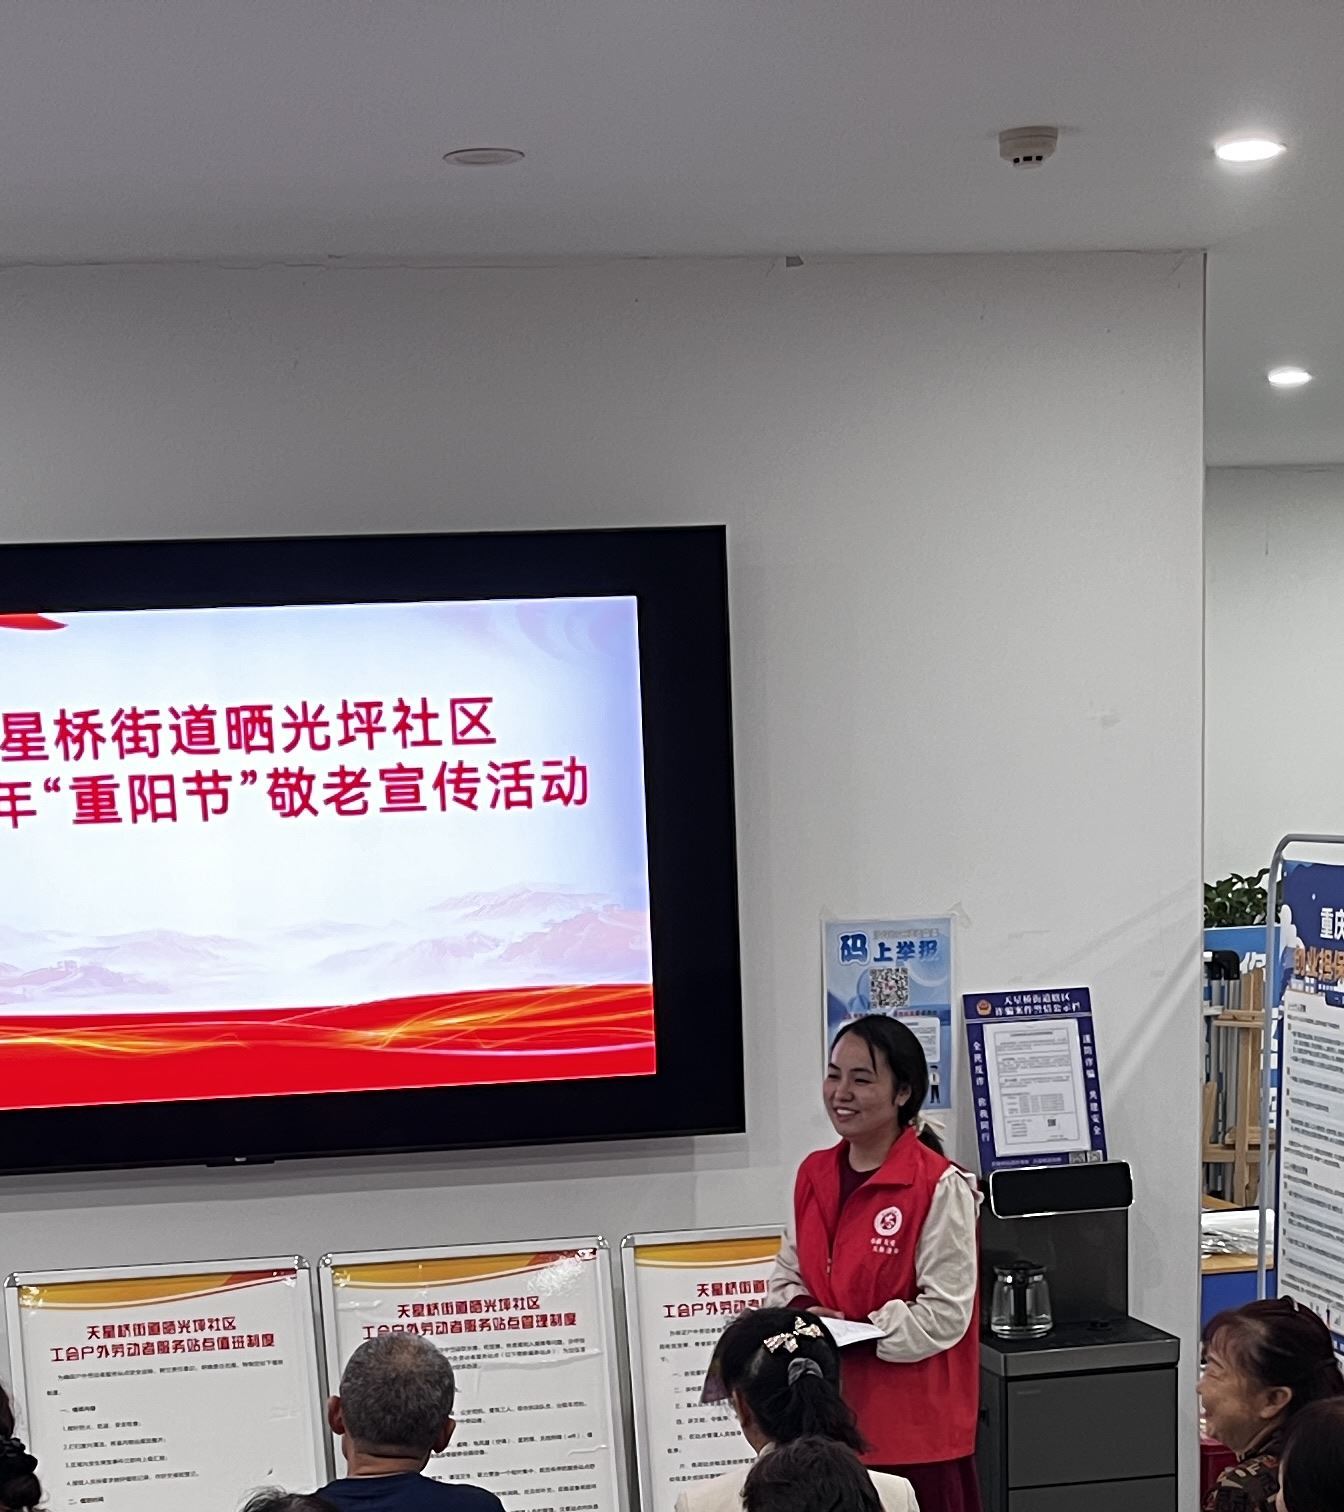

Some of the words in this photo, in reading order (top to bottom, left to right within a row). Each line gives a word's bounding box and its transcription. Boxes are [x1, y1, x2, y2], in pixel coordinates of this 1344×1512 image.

[840, 933, 937, 962] 码上举报
[397, 1296, 540, 1319] 天星桥街道晒光坪社区
[86, 1316, 236, 1341] 天星桥街道晒光坪社区
[50, 1333, 275, 1363] 工会户外劳动者服务站点值班制度
